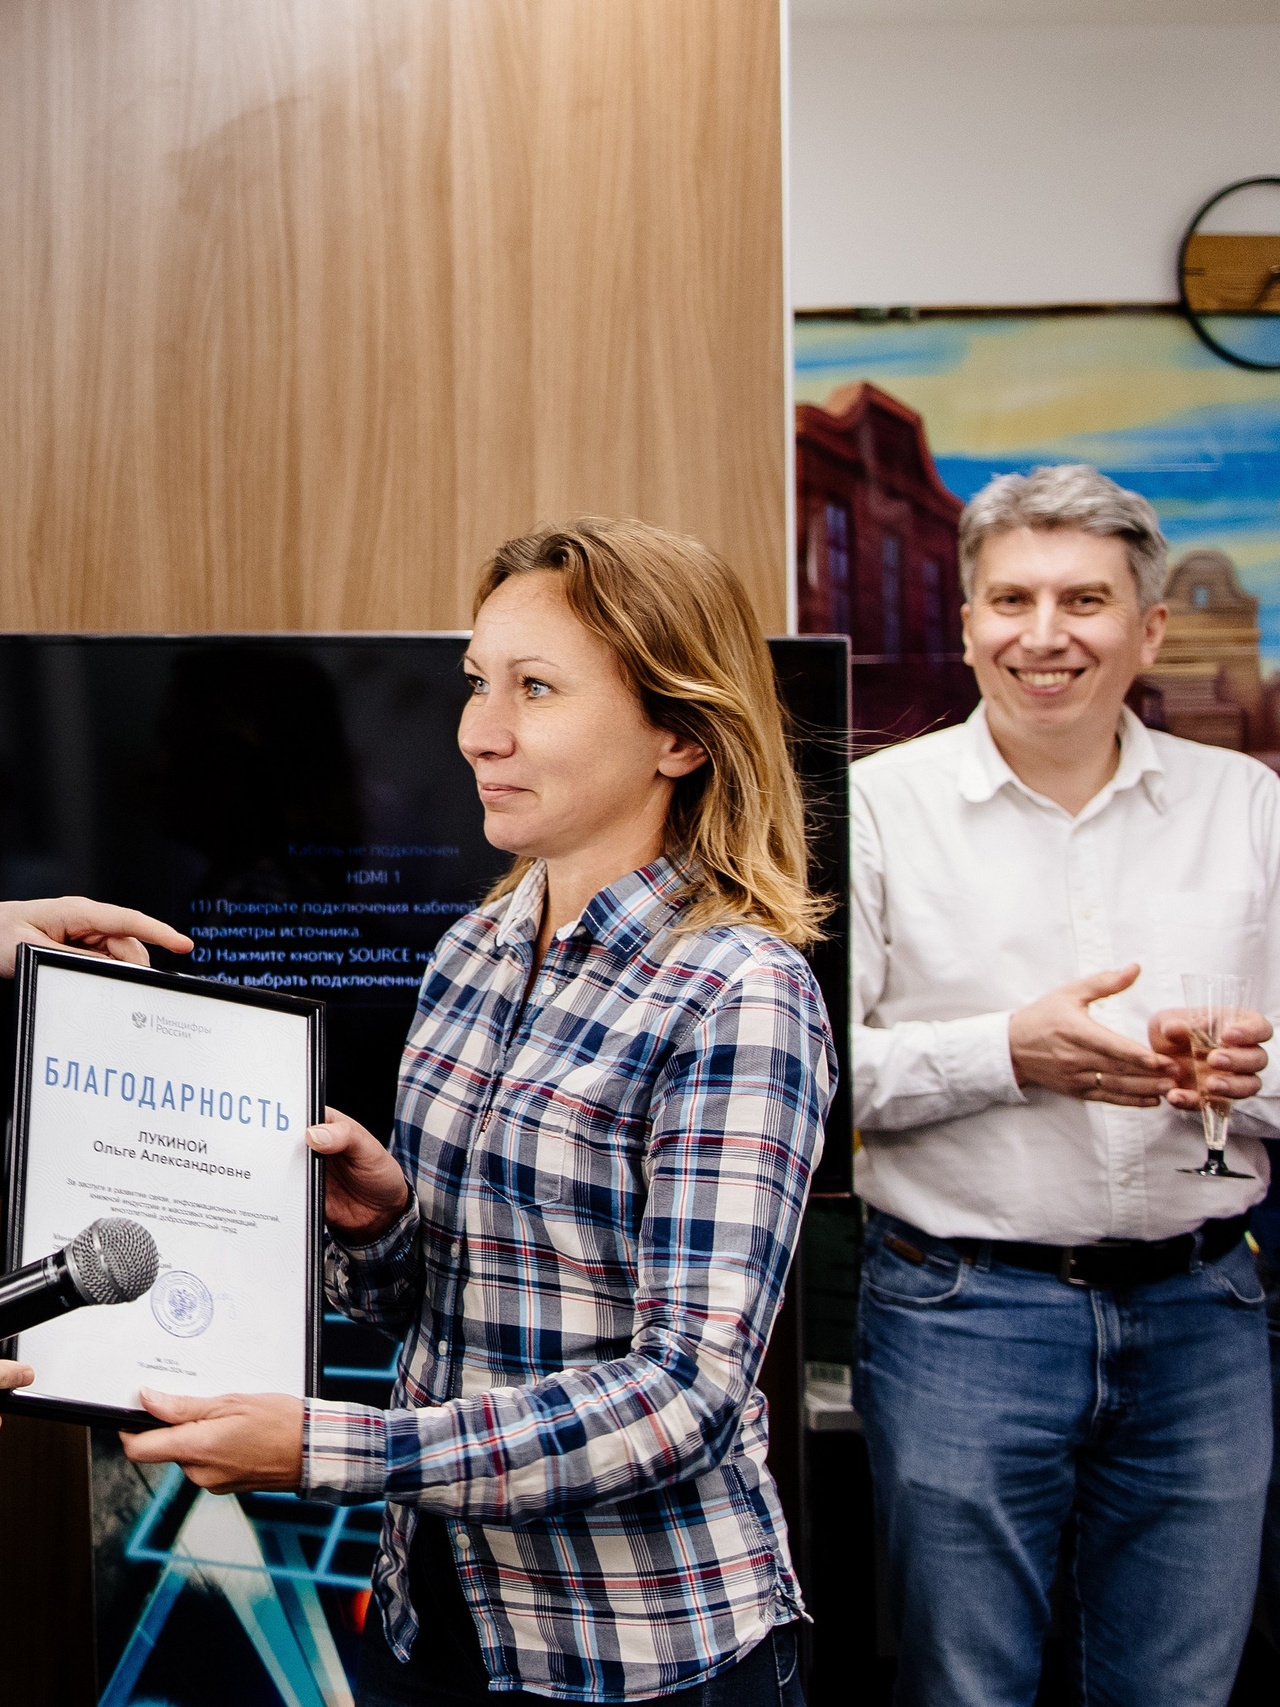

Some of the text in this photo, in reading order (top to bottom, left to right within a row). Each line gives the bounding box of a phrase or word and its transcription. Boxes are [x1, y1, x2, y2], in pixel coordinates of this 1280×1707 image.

[370, 846, 460, 858] подключен
[346, 869, 401, 885] HDMI 1
[190, 899, 212, 914] (1)
[216, 899, 298, 917] Проверьте
[302, 901, 409, 917] подключения
[190, 926, 363, 942] параметры источника.
[191, 948, 212, 964] (2)
[216, 949, 286, 963] Нажмите
[290, 951, 344, 965] кнопку
[348, 947, 410, 963] SOURCE
[243, 971, 308, 989] выбрать
[311, 974, 422, 989] подключенны
[156, 1015, 212, 1034] Минцифры
[156, 1024, 192, 1039] России
[45, 1056, 289, 1131] БЛАГОДАРНОСТЬ
[138, 1131, 208, 1154] ЛУКИНОЙ
[93, 1140, 251, 1179] Ольге Александровне
